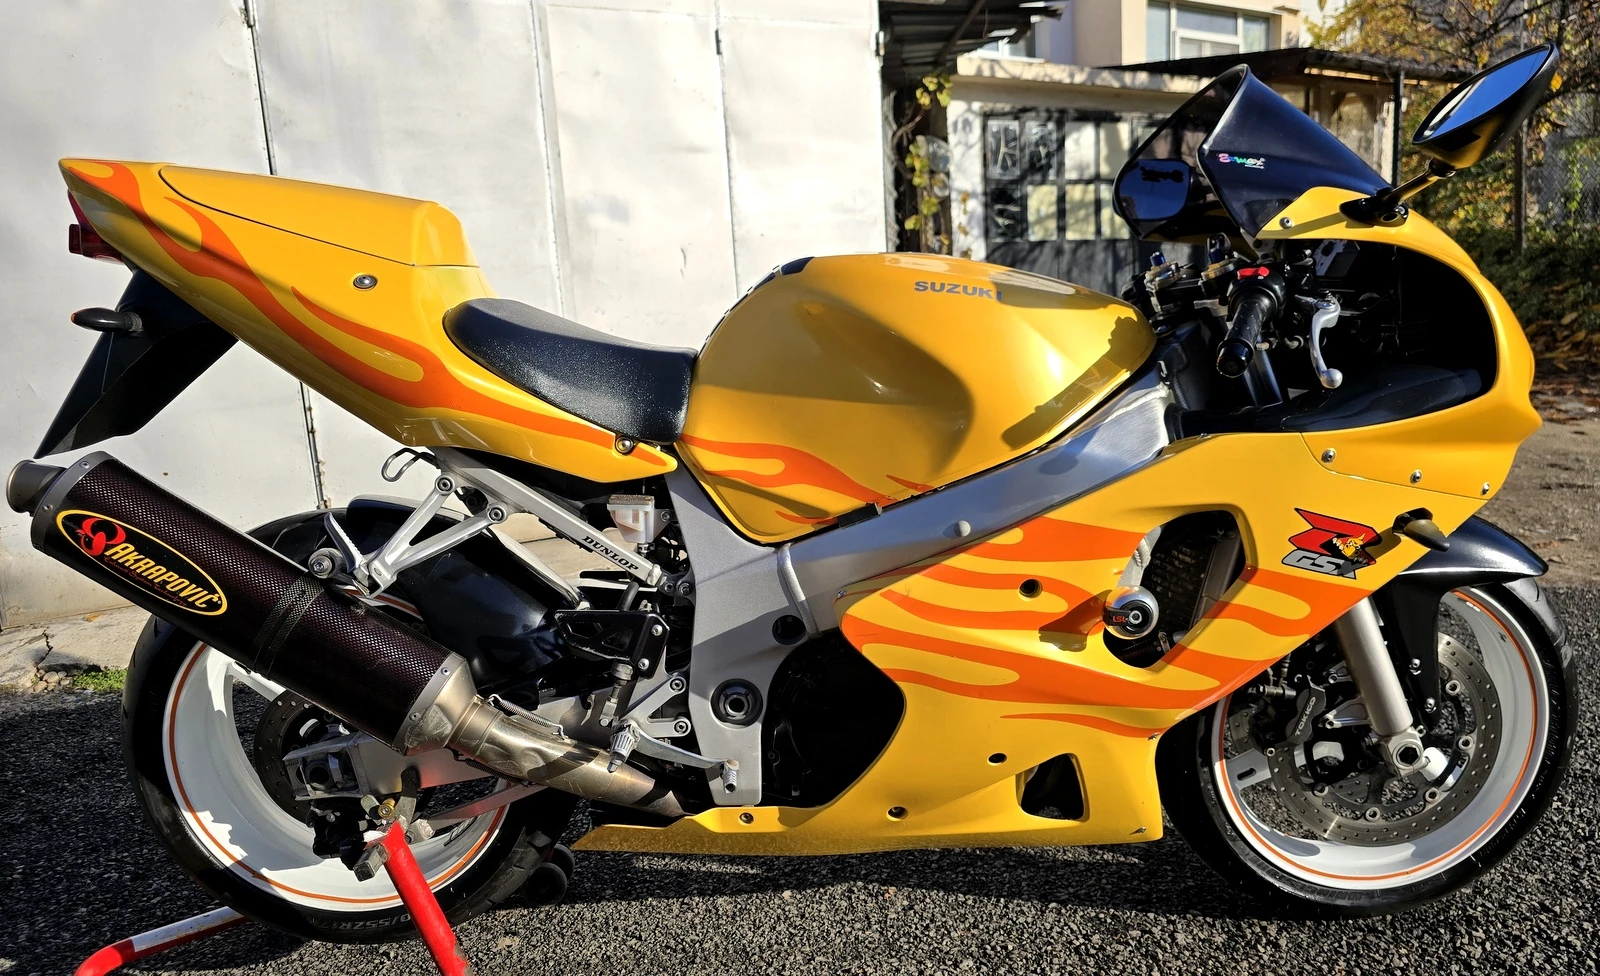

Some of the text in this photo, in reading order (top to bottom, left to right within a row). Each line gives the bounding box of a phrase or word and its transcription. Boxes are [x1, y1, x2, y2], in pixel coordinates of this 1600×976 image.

[914, 280, 1002, 301] SUZUKI
[582, 536, 639, 570] DUNLOP
[1294, 696, 1316, 736] TOKICO
